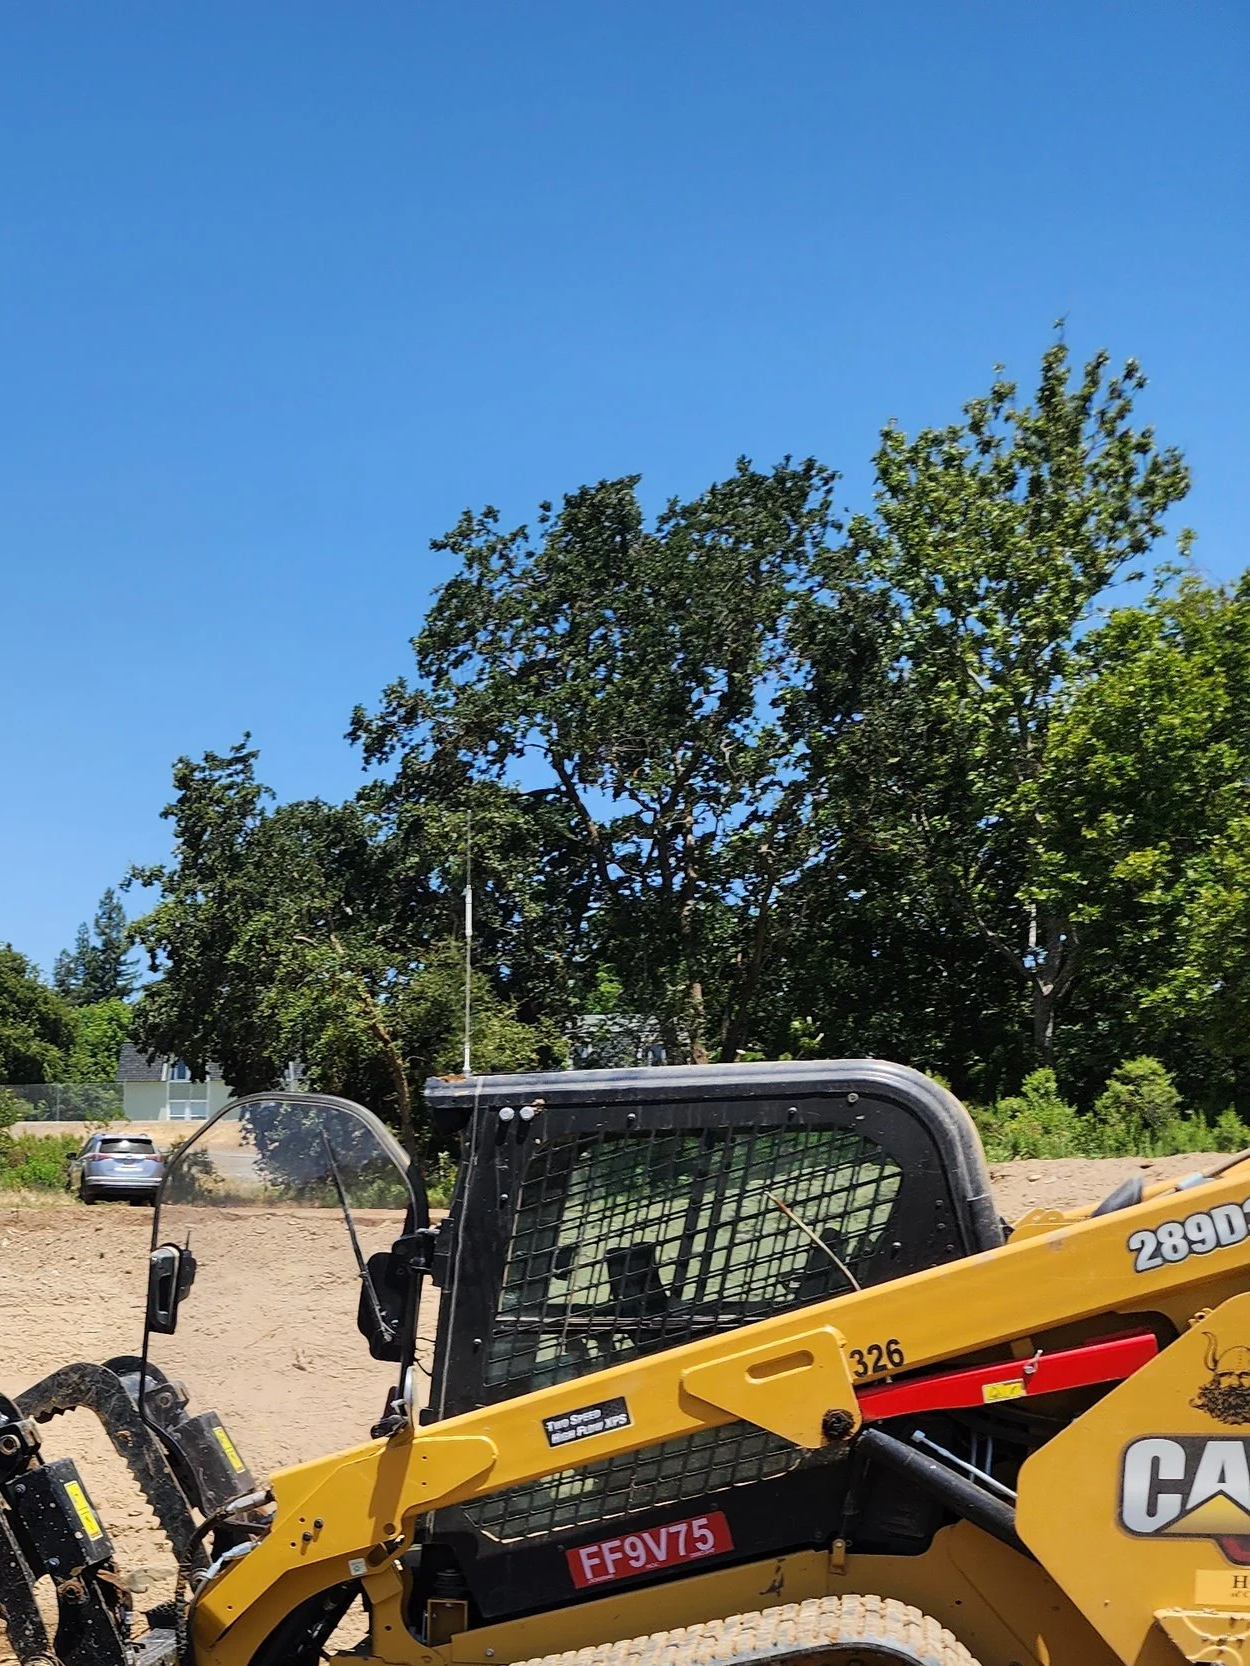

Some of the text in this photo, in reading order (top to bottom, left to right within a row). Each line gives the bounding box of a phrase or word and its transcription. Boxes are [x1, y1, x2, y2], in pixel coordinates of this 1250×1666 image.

[1128, 1198, 1250, 1272] 289D
[849, 1338, 905, 1378] 326
[579, 1517, 715, 1580] FF9V75
